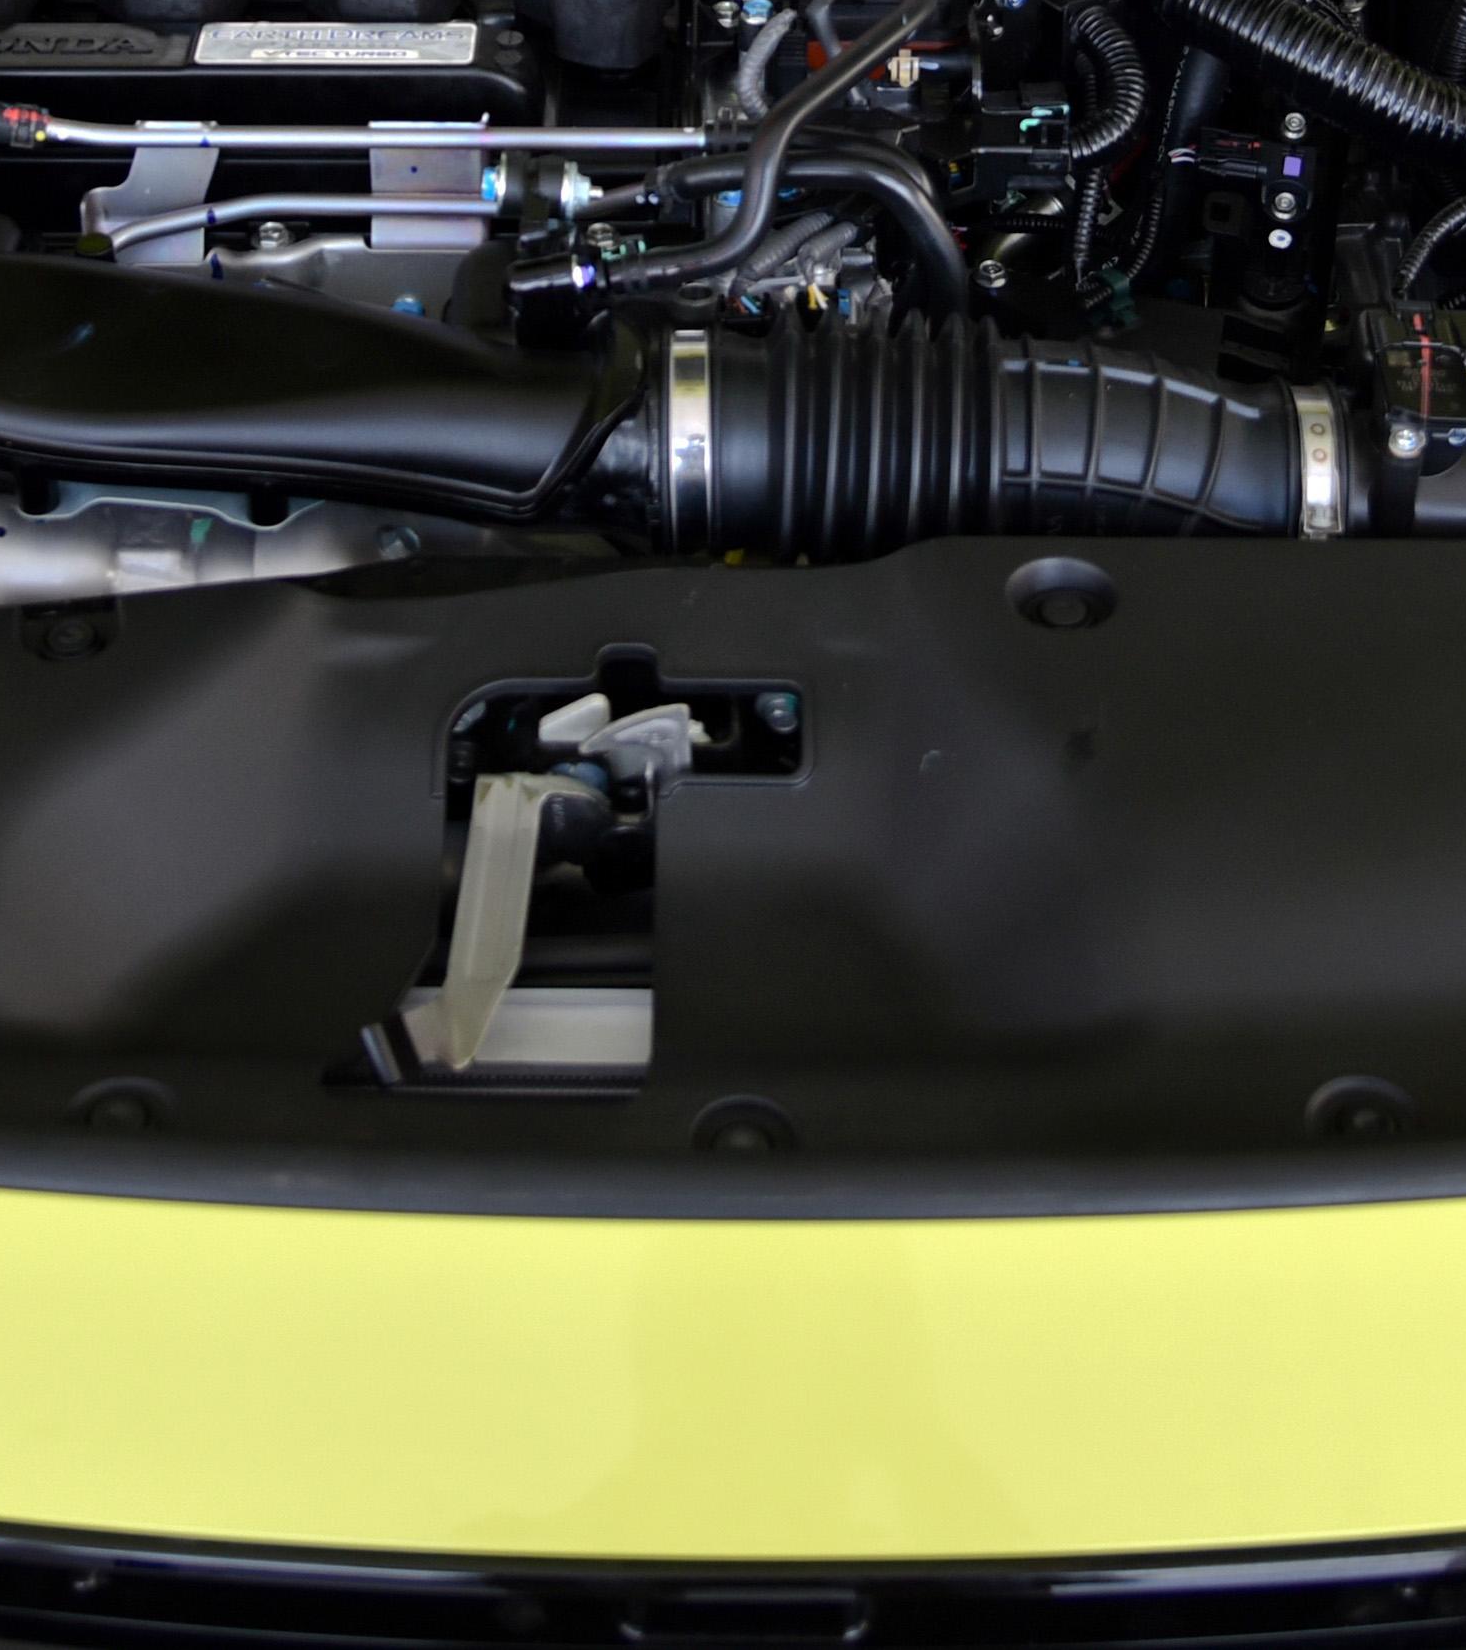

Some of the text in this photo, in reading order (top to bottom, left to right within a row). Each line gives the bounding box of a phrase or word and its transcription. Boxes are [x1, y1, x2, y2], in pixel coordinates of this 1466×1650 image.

[210, 29, 464, 40] EARTH DREAMS
[262, 49, 408, 58] VTEC TURBO
